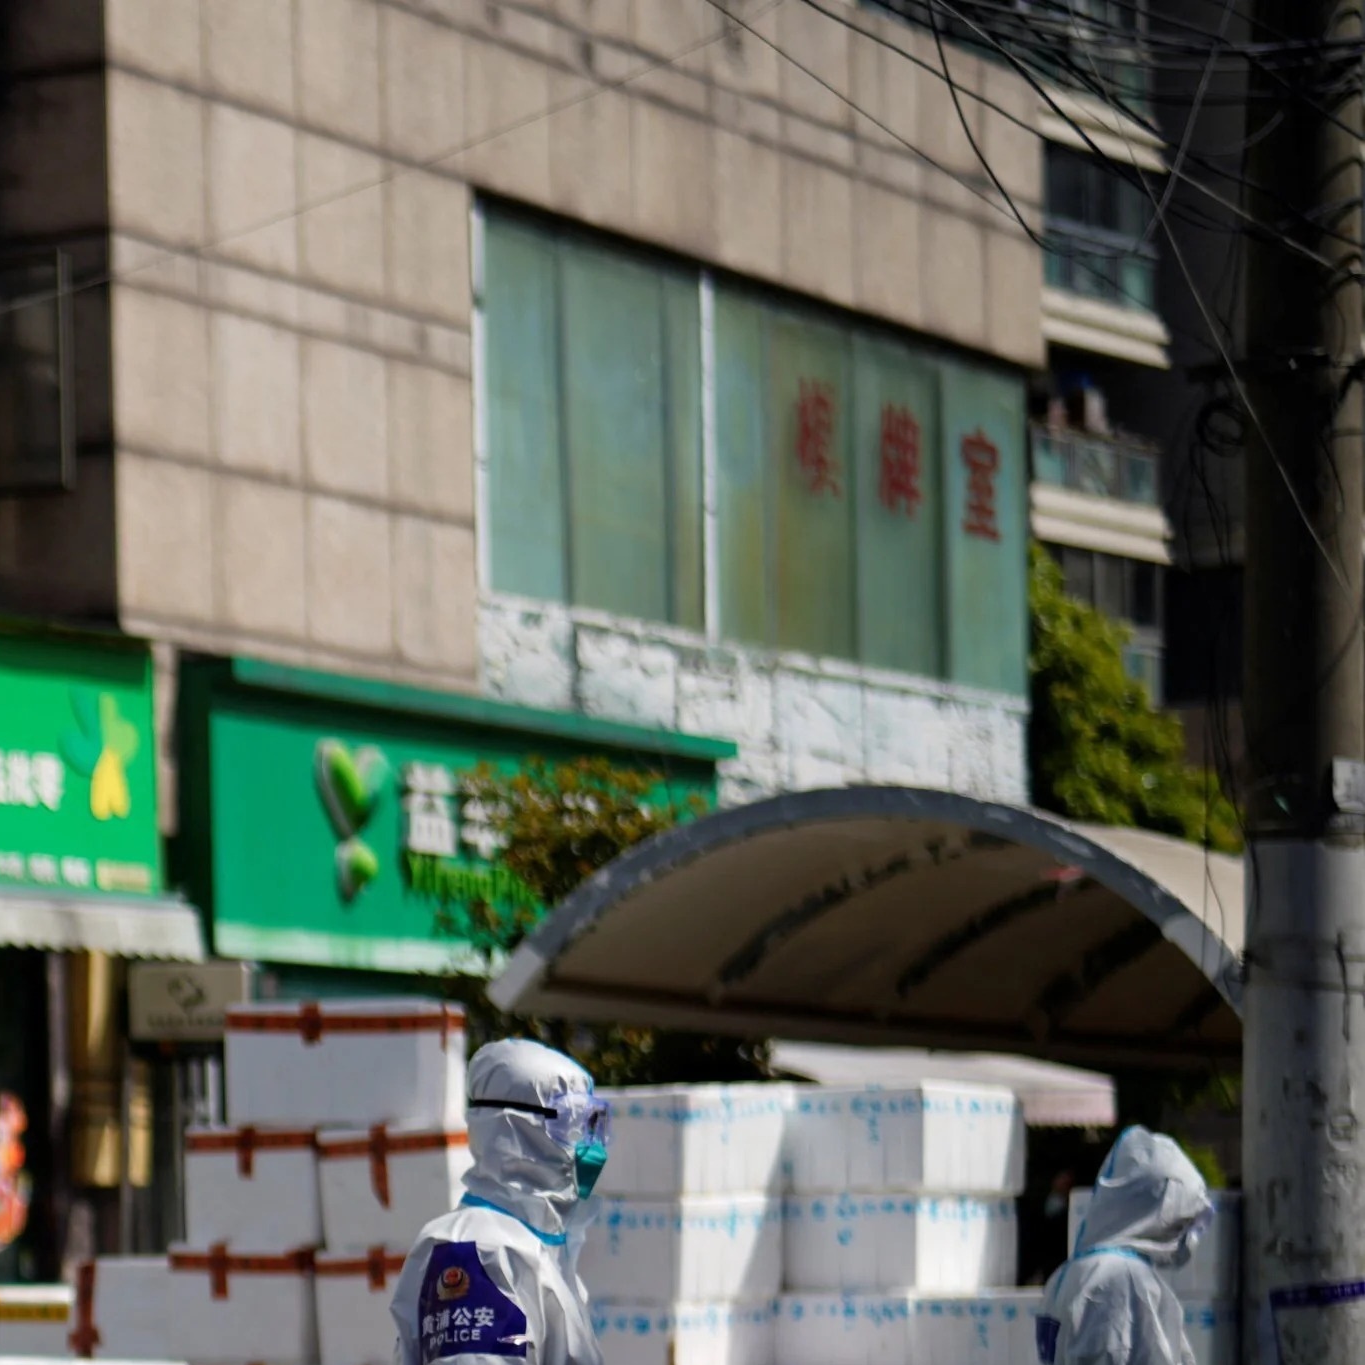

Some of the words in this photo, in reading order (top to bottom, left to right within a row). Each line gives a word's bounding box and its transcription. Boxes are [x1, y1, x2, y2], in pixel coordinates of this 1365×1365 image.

[422, 1306, 494, 1337] 黄浦公安
[430, 1329, 481, 1348] POLICE
